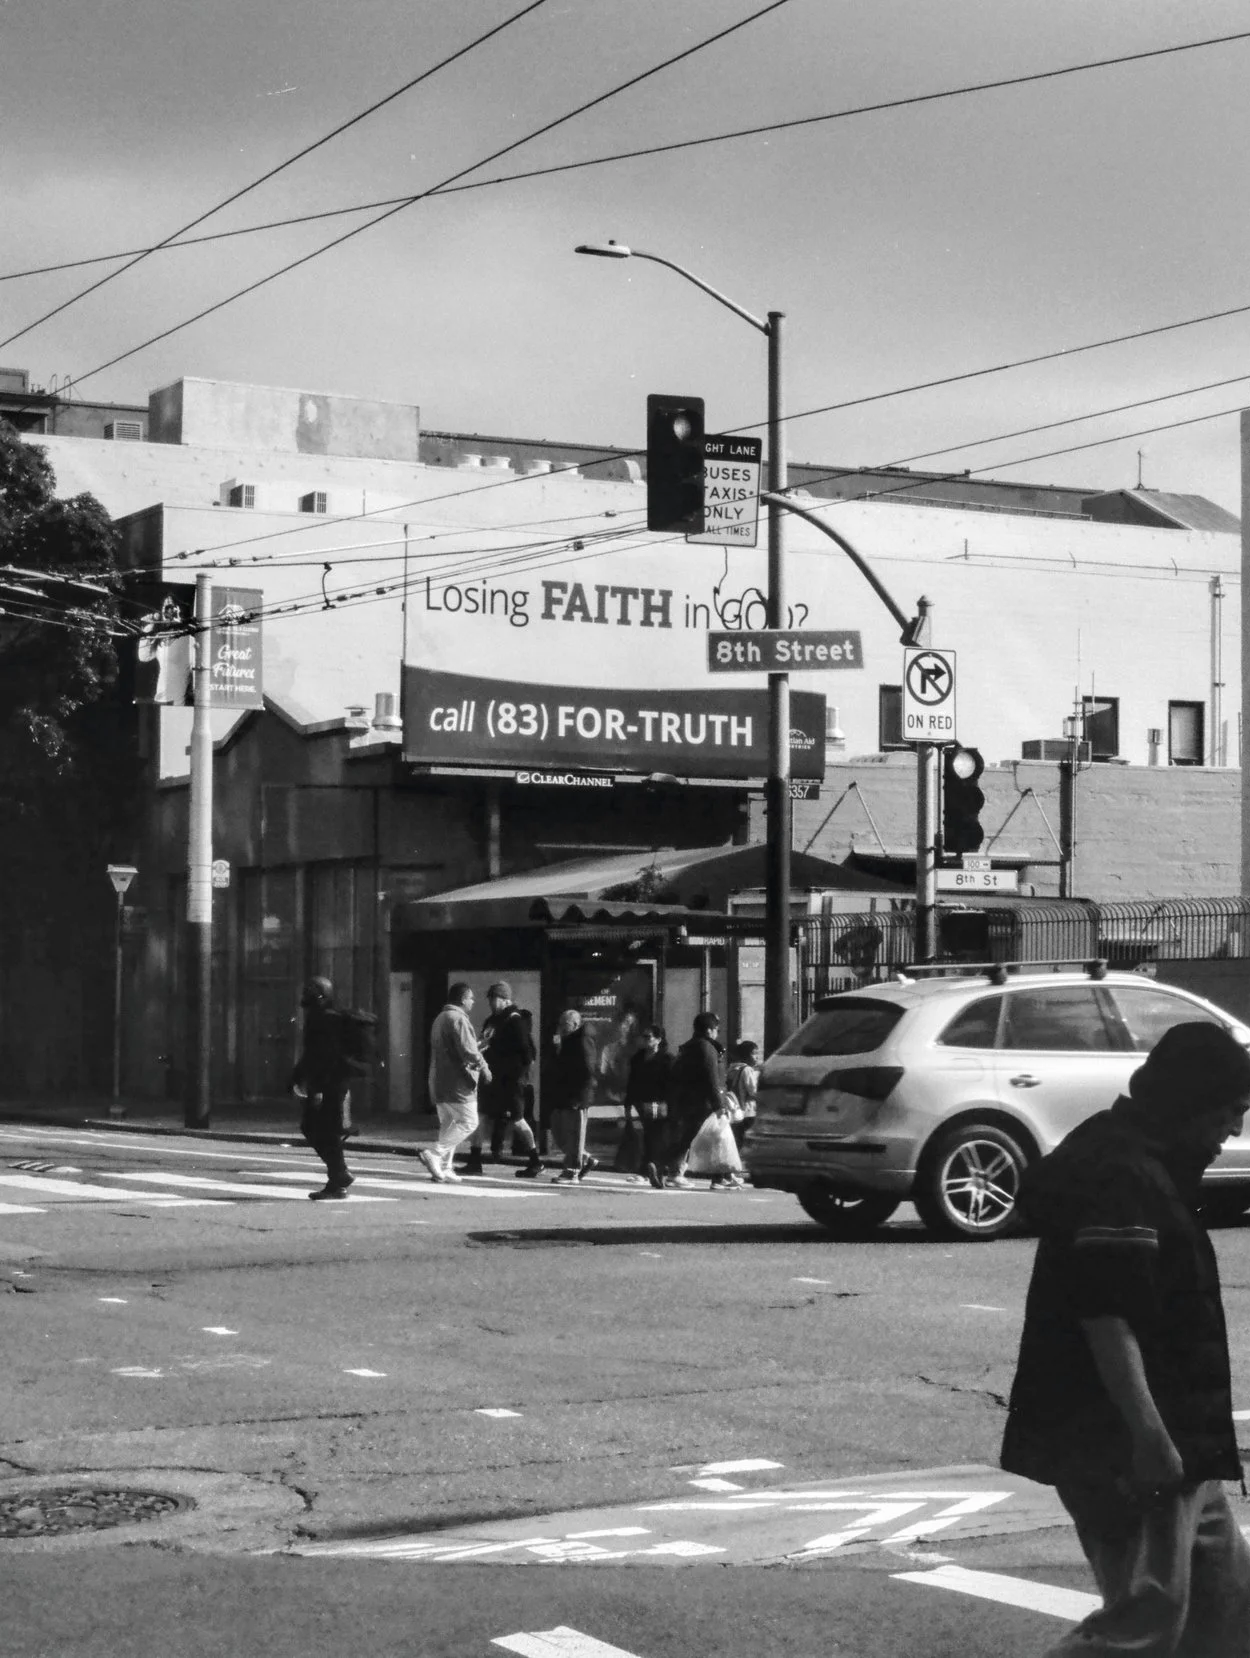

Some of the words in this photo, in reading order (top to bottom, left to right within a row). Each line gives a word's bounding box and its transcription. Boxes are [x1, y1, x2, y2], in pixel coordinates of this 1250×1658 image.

[705, 443, 724, 454] GHT
[730, 445, 756, 456] LANE
[706, 525, 722, 535] ALL
[726, 526, 750, 537] TIMES
[426, 576, 530, 628] Losing
[541, 579, 673, 629] FAITH
[685, 594, 710, 630] in
[217, 644, 252, 661] Great
[716, 640, 761, 663] 8th
[775, 639, 855, 663] Street
[429, 700, 475, 732] call
[487, 700, 549, 741] (83)
[557, 706, 753, 747] FOR-TRUTH
[907, 714, 924, 729] ON
[928, 716, 953, 730] RED
[955, 874, 976, 886] 8th
[983, 874, 998, 886] St
